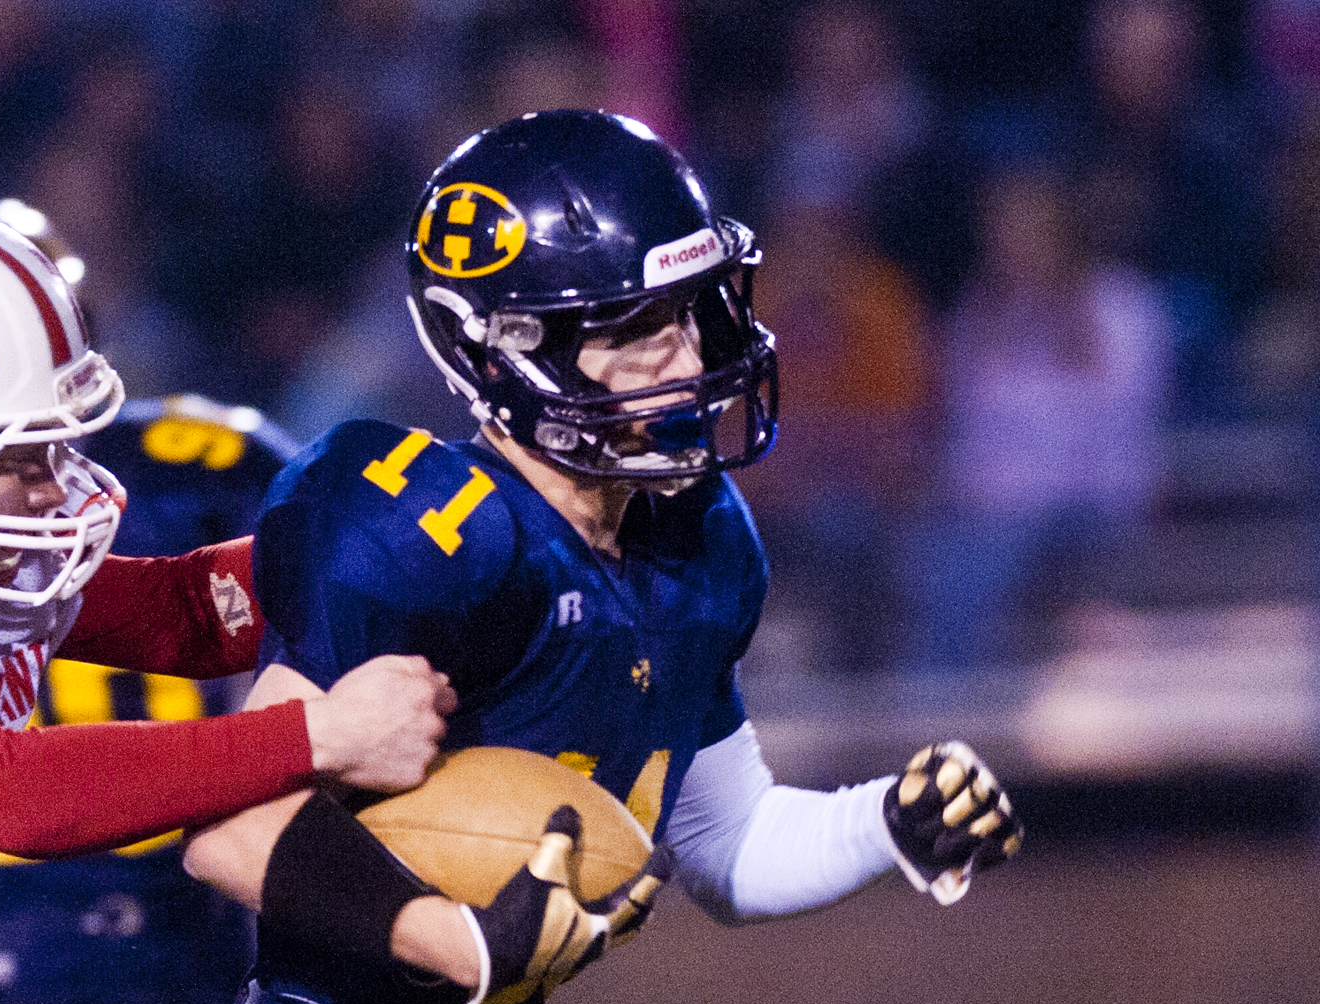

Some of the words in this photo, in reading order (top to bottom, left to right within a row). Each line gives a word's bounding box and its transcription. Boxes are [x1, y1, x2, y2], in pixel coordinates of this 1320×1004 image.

[420, 185, 520, 275] H
[658, 236, 717, 270] Riddell
[361, 431, 497, 557] 11
